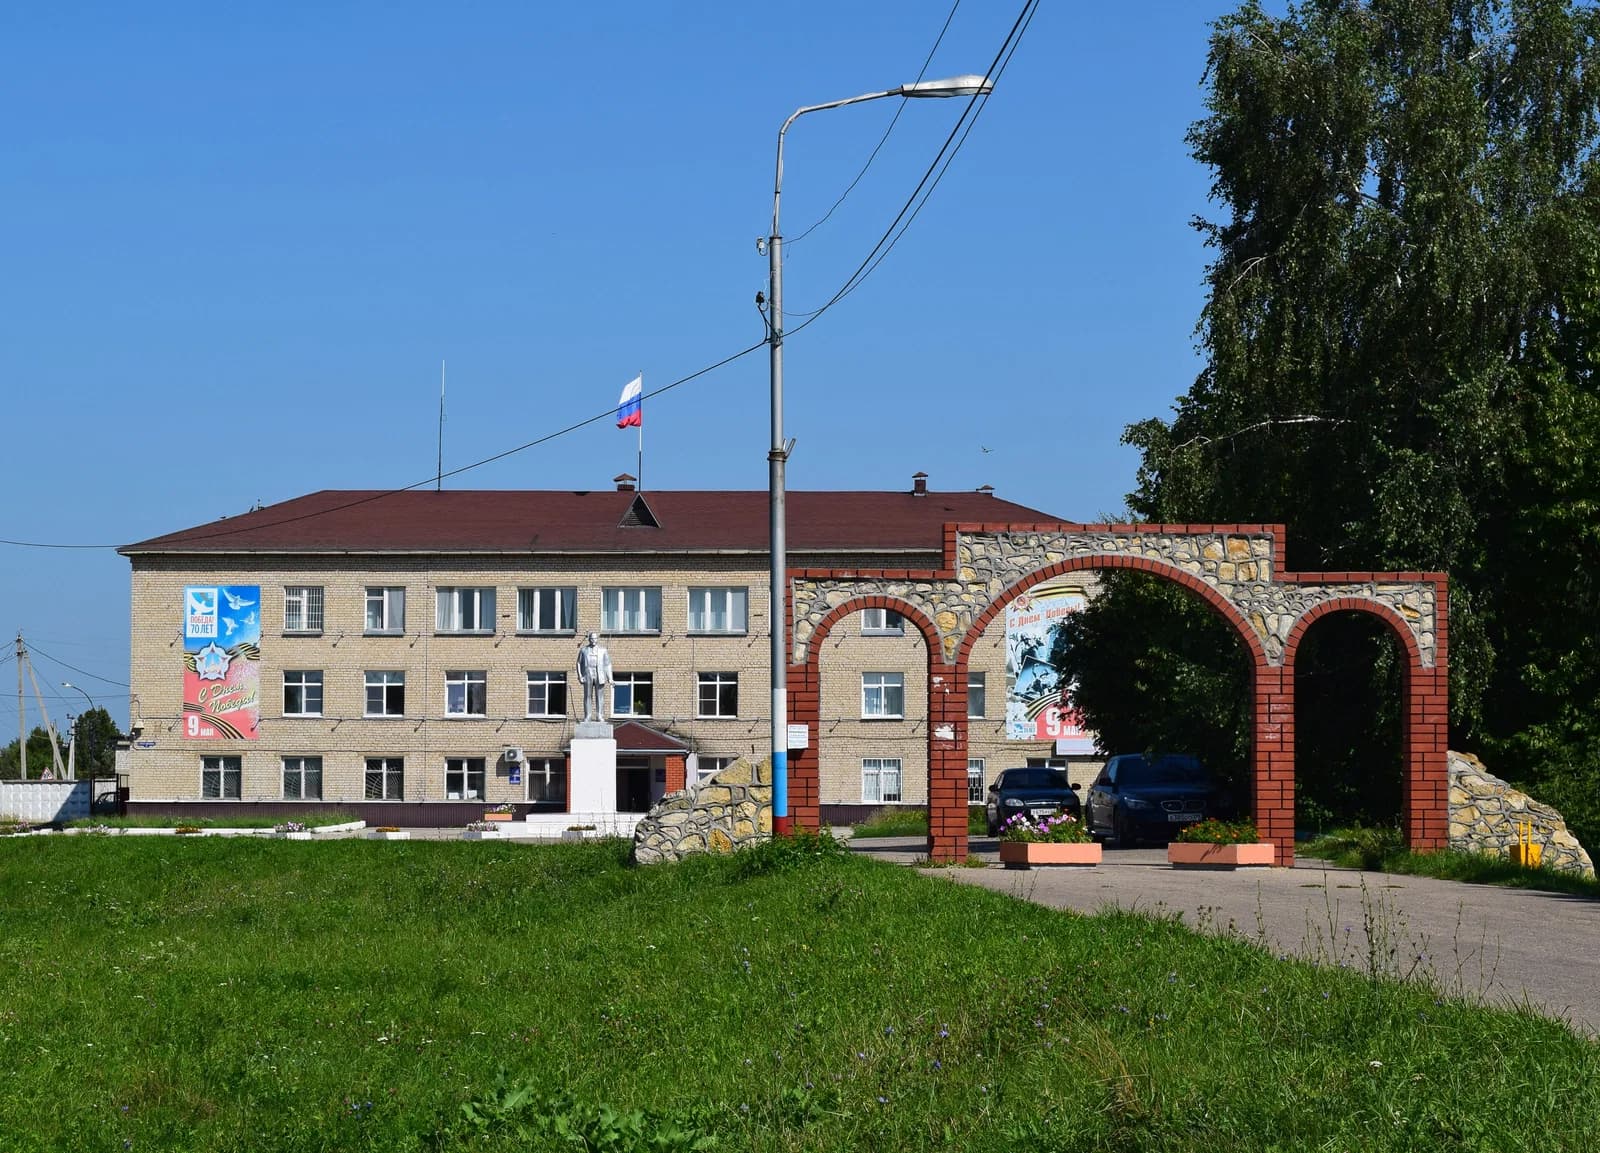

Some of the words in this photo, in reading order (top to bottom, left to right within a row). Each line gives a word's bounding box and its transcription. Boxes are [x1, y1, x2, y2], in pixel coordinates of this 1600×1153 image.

[191, 625, 200, 634] 70
[201, 625, 214, 634] ЛЕТ
[1009, 618, 1015, 628] С
[198, 687, 208, 704] С
[188, 715, 199, 737] 9
[1045, 707, 1061, 737] 9
